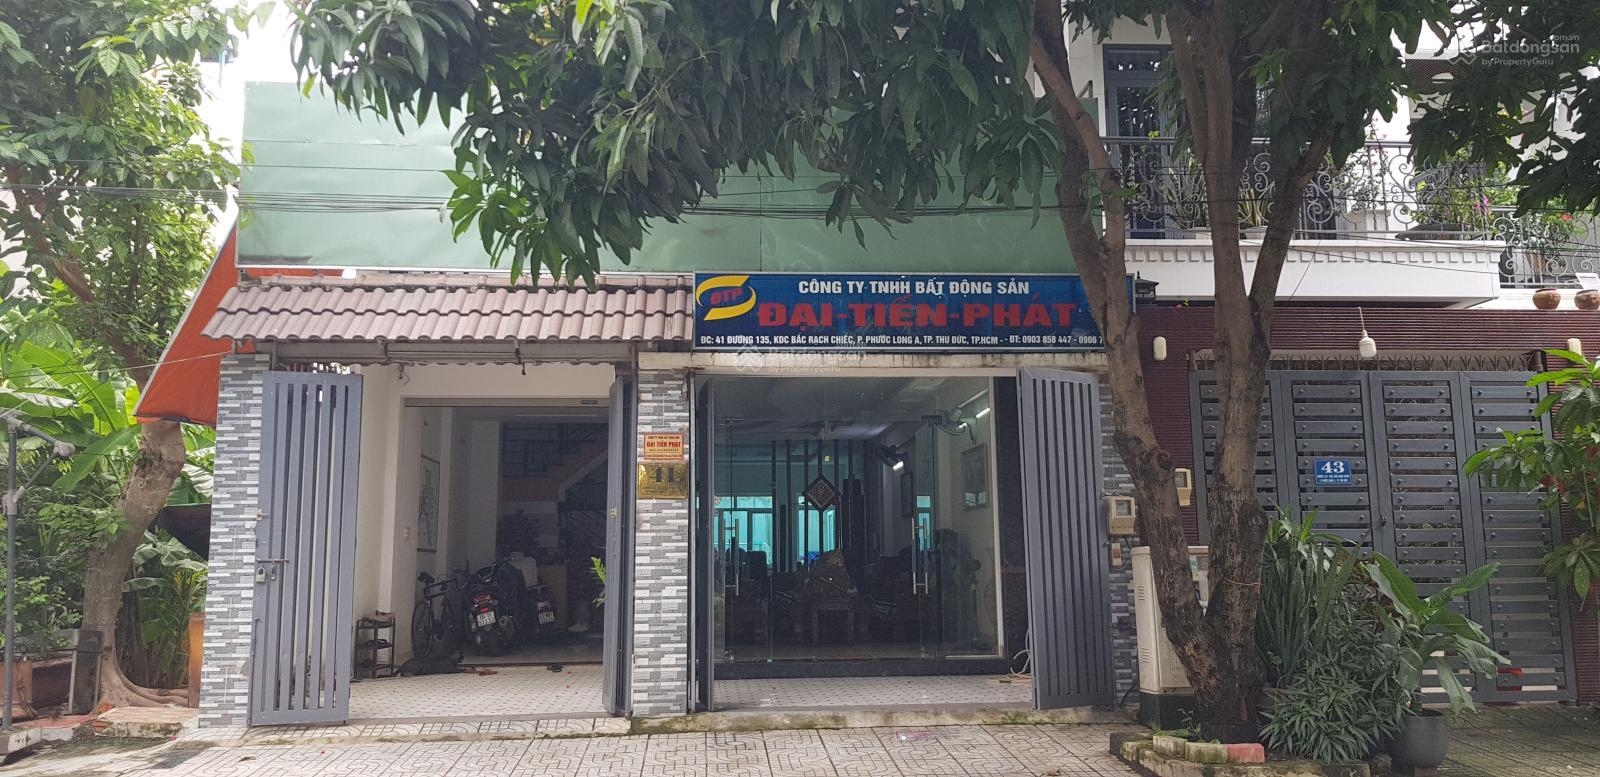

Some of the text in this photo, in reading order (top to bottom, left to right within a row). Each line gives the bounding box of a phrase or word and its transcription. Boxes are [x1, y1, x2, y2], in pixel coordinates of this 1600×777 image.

[798, 277, 1029, 298] CÔNG TY TNHH BẤT ĐỘNG SẢN
[758, 294, 1078, 331] ĐẠI-TIẾN-PHÁT
[700, 336, 714, 344] ĐC:
[716, 336, 724, 344] 41
[756, 336, 772, 344] 135,
[774, 336, 790, 344] KDC
[808, 336, 828, 345] RẠCH
[857, 336, 864, 344] P.
[892, 336, 912, 344] LONG
[914, 336, 922, 344] A,
[924, 336, 933, 344] TP.
[971, 336, 998, 344] TP.HCM
[1022, 335, 1040, 343] 0903
[1078, 336, 1096, 344] 0906
[1320, 461, 1345, 474] 43
